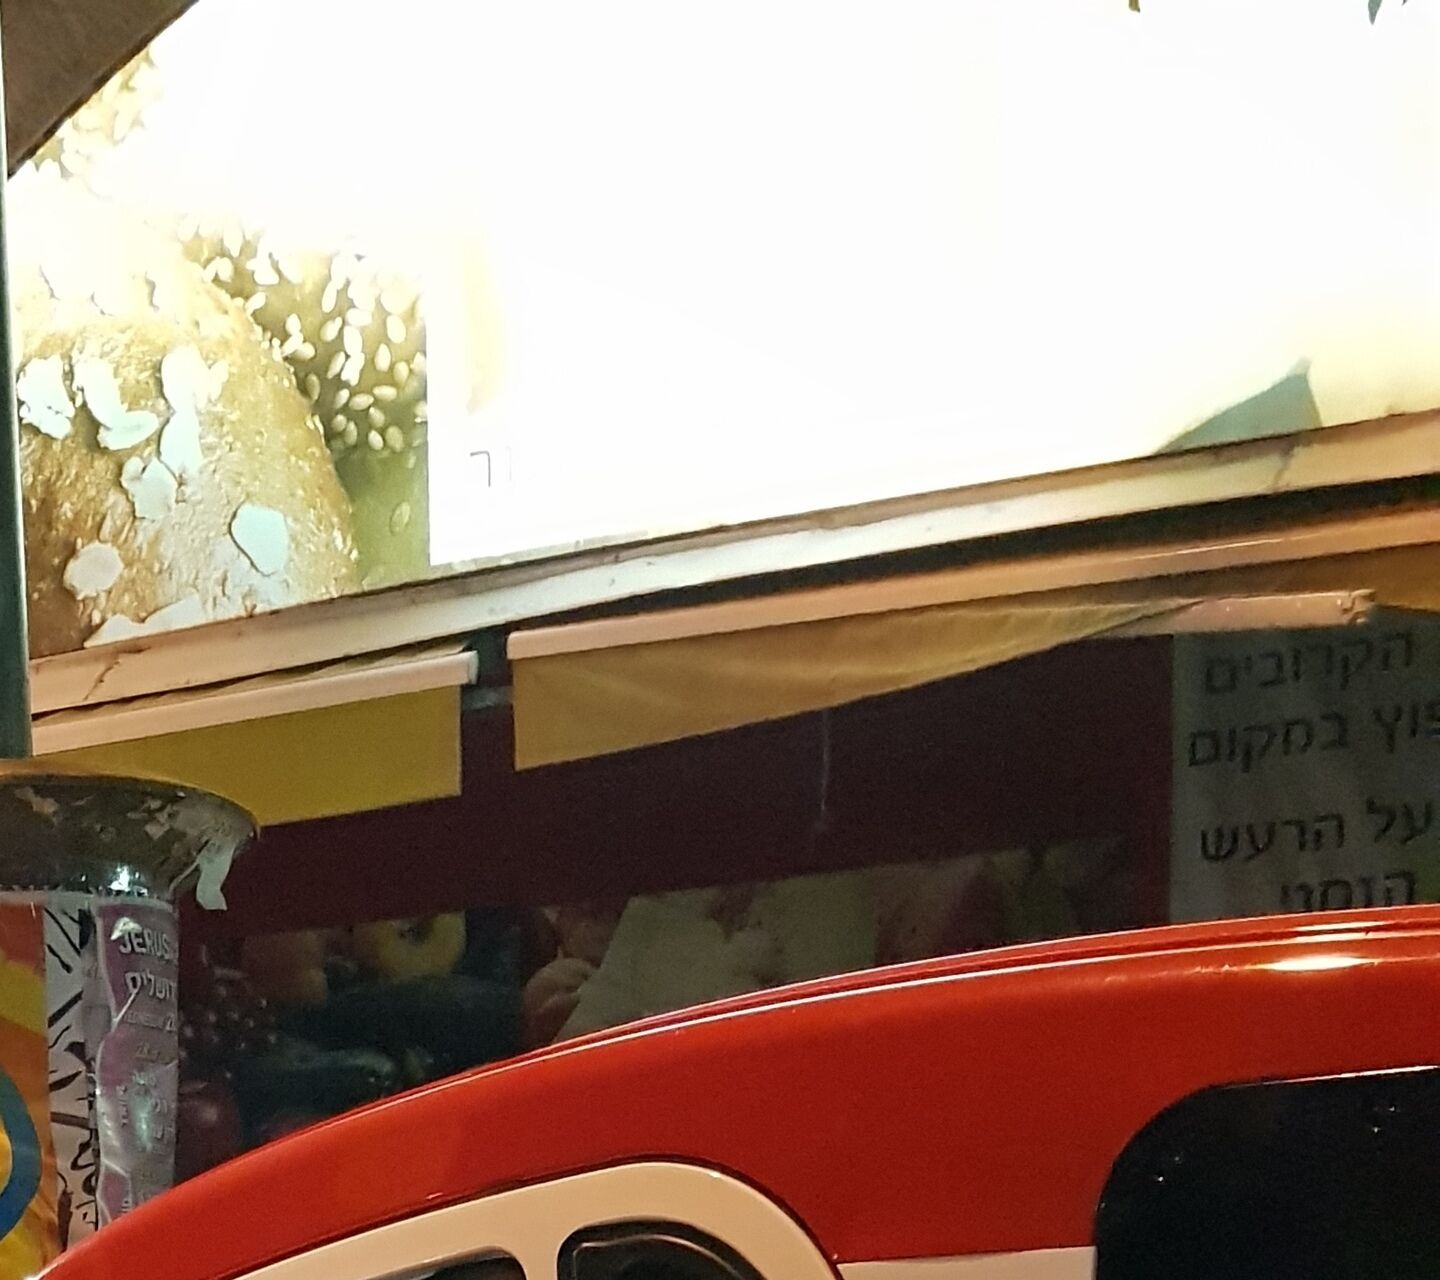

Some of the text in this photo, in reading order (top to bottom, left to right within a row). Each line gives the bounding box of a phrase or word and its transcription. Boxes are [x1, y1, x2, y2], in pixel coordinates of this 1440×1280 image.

[1203, 629, 1414, 694] הקרובים
[1187, 710, 1350, 774] במקום
[1200, 796, 1433, 864] על הרעש
